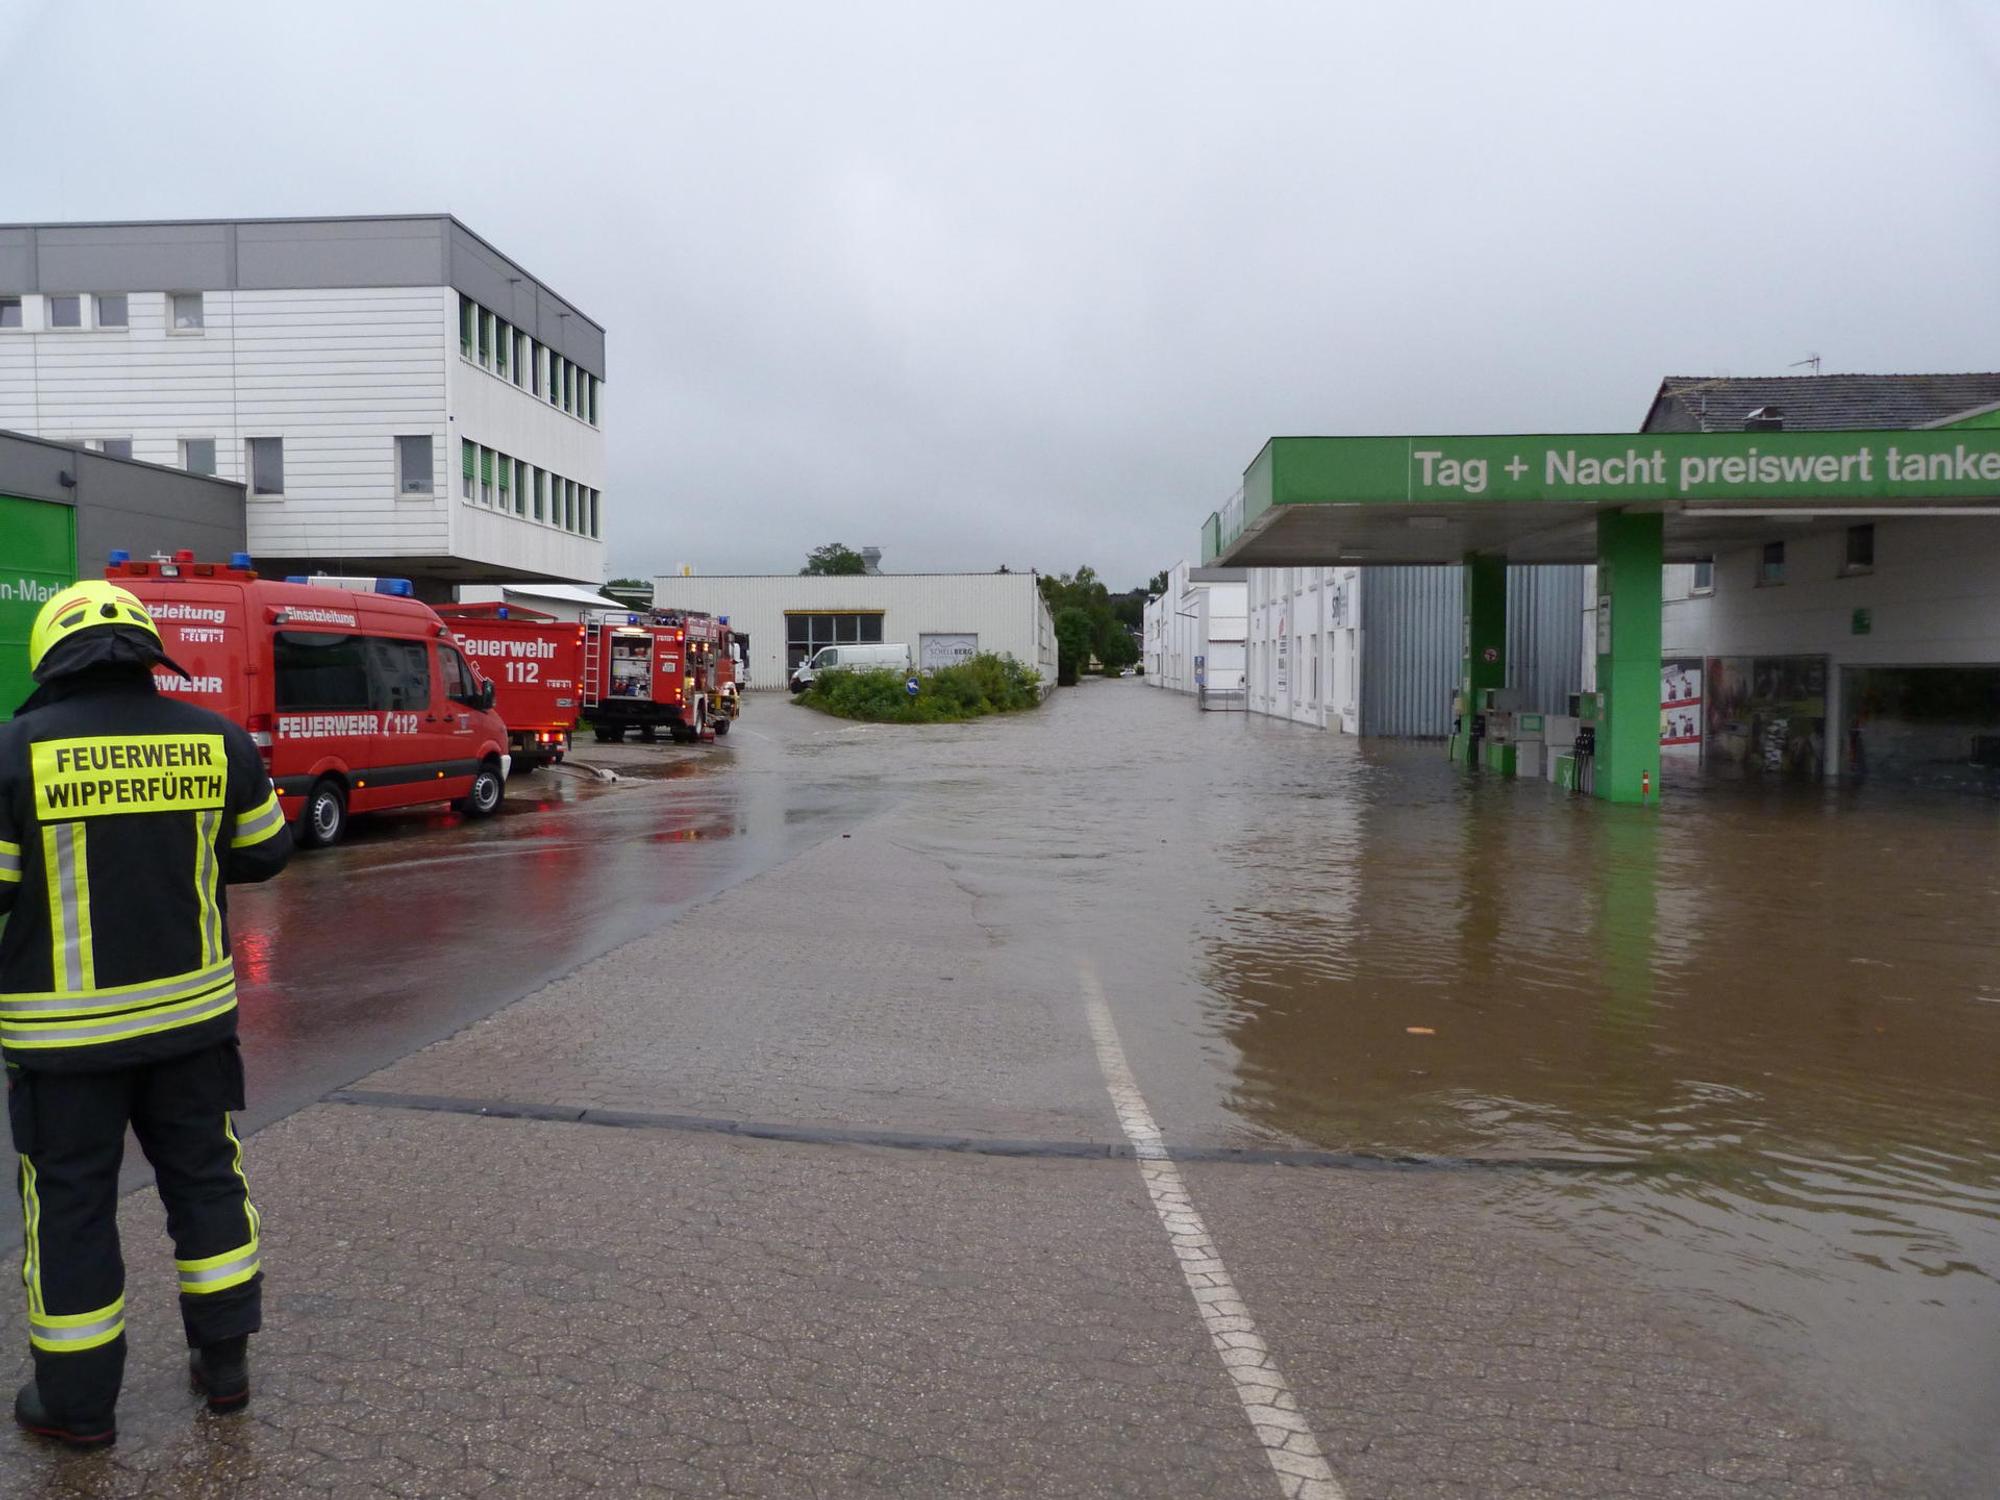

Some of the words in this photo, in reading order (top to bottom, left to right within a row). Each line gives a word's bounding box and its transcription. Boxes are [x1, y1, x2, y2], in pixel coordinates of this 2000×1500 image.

[1414, 451, 1488, 493] Tag
[1504, 455, 1529, 481] +
[1545, 449, 1666, 486] Nacht
[1679, 447, 1873, 491] preiswert
[1886, 445, 2000, 481] tanke
[284, 605, 356, 628] Einsatzleitung
[452, 633, 558, 659] Feuerwehr
[505, 661, 539, 683] 112
[278, 715, 379, 739] FEUERWEHR
[394, 714, 418, 735] 112
[56, 743, 212, 773] FEUERWEHR
[45, 772, 222, 808] WIPPERFÜRTH
